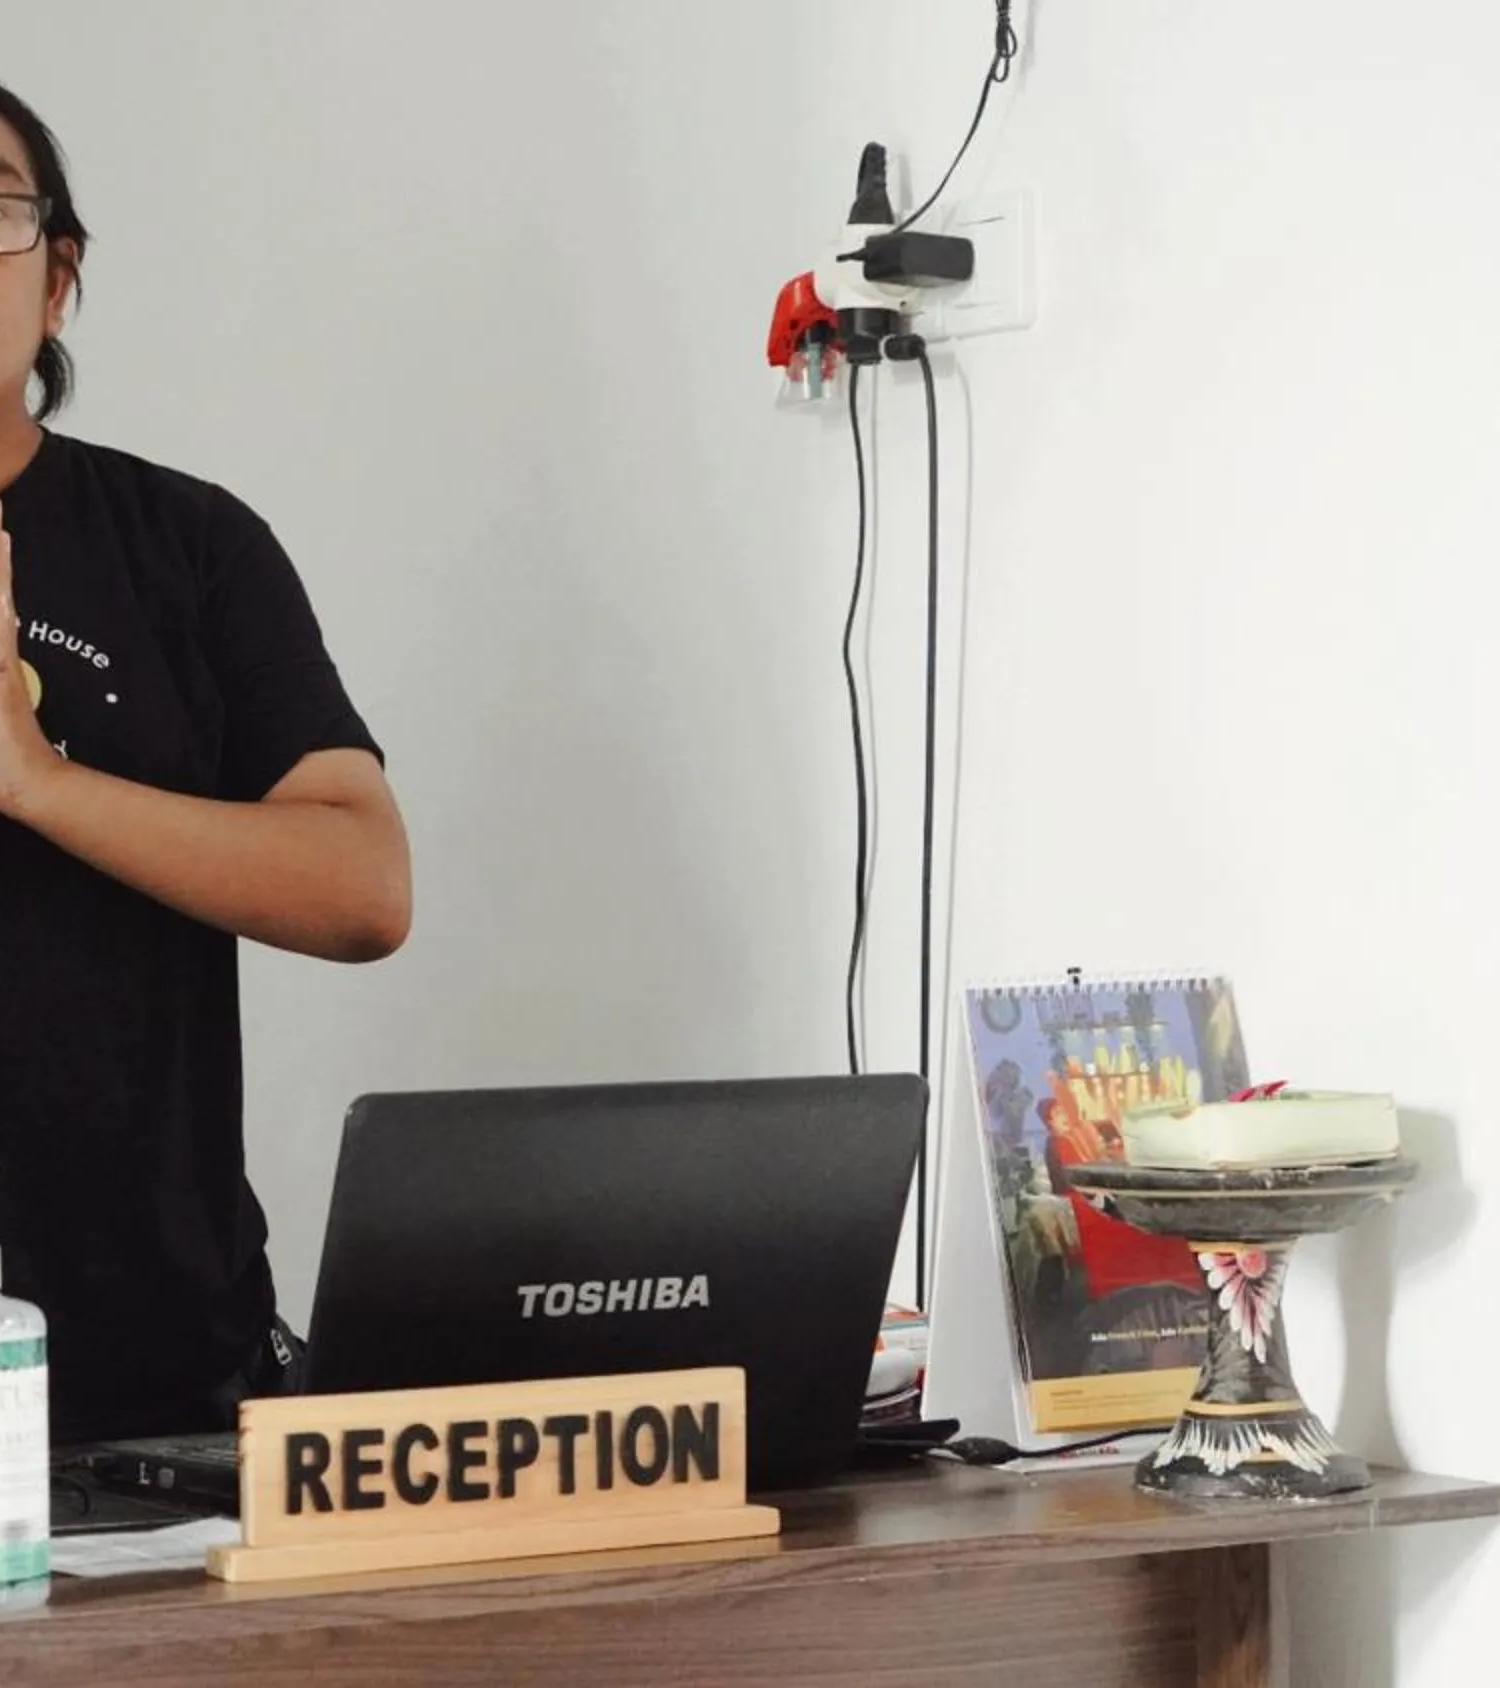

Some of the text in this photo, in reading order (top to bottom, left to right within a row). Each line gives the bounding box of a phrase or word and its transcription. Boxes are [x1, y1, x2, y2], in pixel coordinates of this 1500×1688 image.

[28, 620, 111, 669] House
[518, 1275, 710, 1319] TOSHIBA
[284, 1402, 721, 1516] RECEPTION
